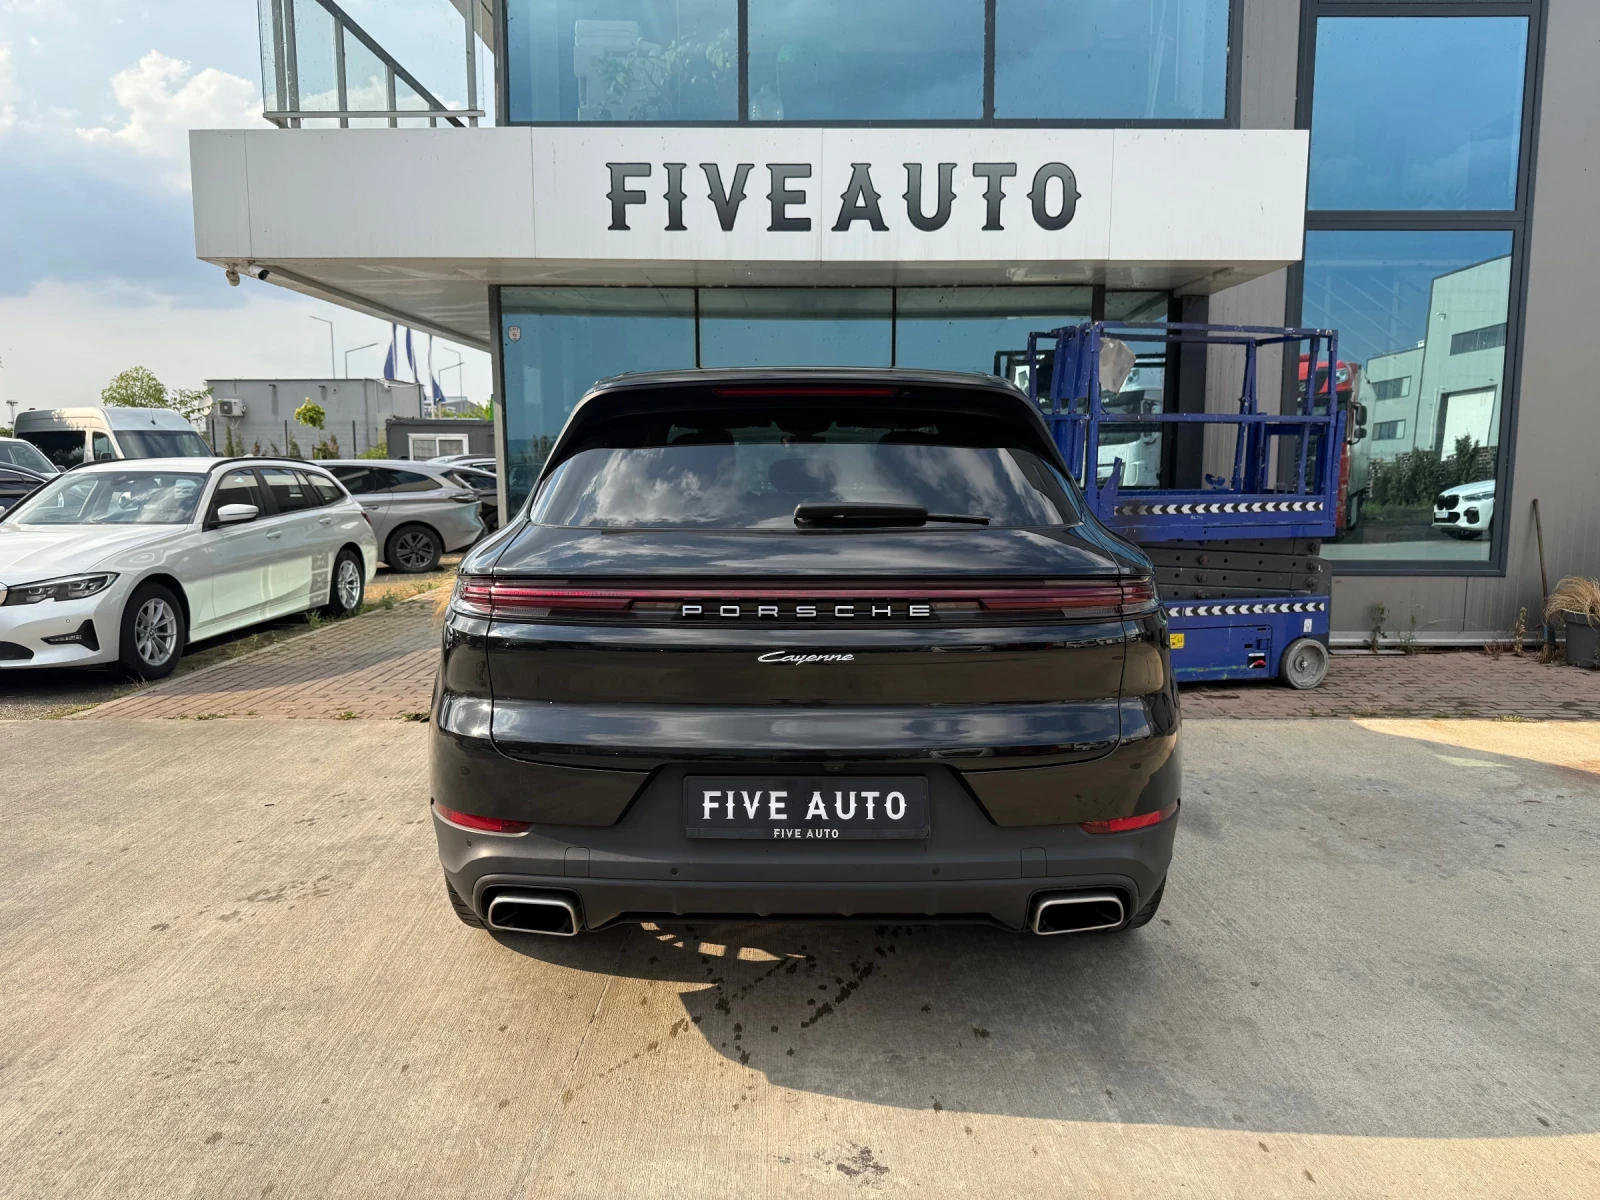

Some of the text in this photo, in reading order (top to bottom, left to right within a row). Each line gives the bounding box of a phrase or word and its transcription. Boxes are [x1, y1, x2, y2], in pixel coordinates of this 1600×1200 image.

[682, 605, 930, 617] PORSCHE
[757, 650, 854, 665] Cayenne
[702, 790, 907, 820] FIVE AUTO
[773, 828, 839, 839] FIVE AUTO
